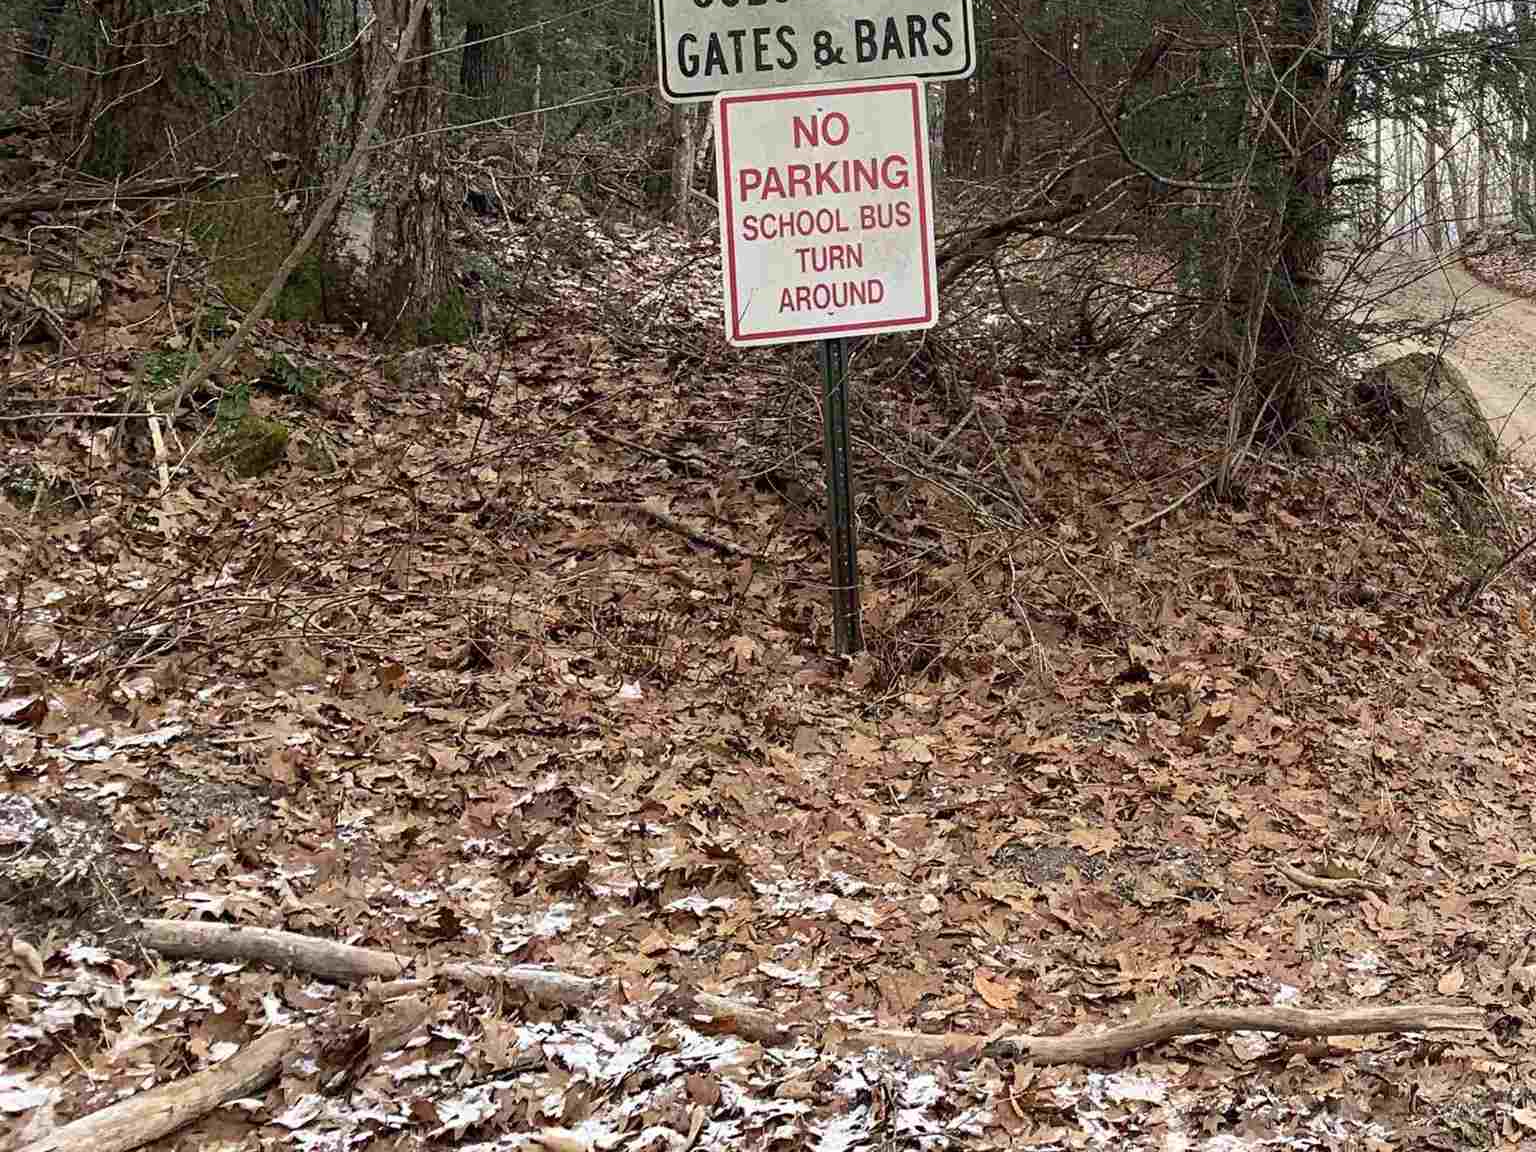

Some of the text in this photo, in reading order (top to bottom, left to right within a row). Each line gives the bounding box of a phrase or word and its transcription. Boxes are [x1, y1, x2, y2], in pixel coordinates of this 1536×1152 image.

[678, 12, 953, 78] GATES & BARS
[793, 112, 850, 148] NO
[739, 155, 909, 202] PARKING
[742, 201, 911, 241] SCHOOL BUS
[796, 243, 863, 273] TURN
[778, 279, 884, 313] AROUND
